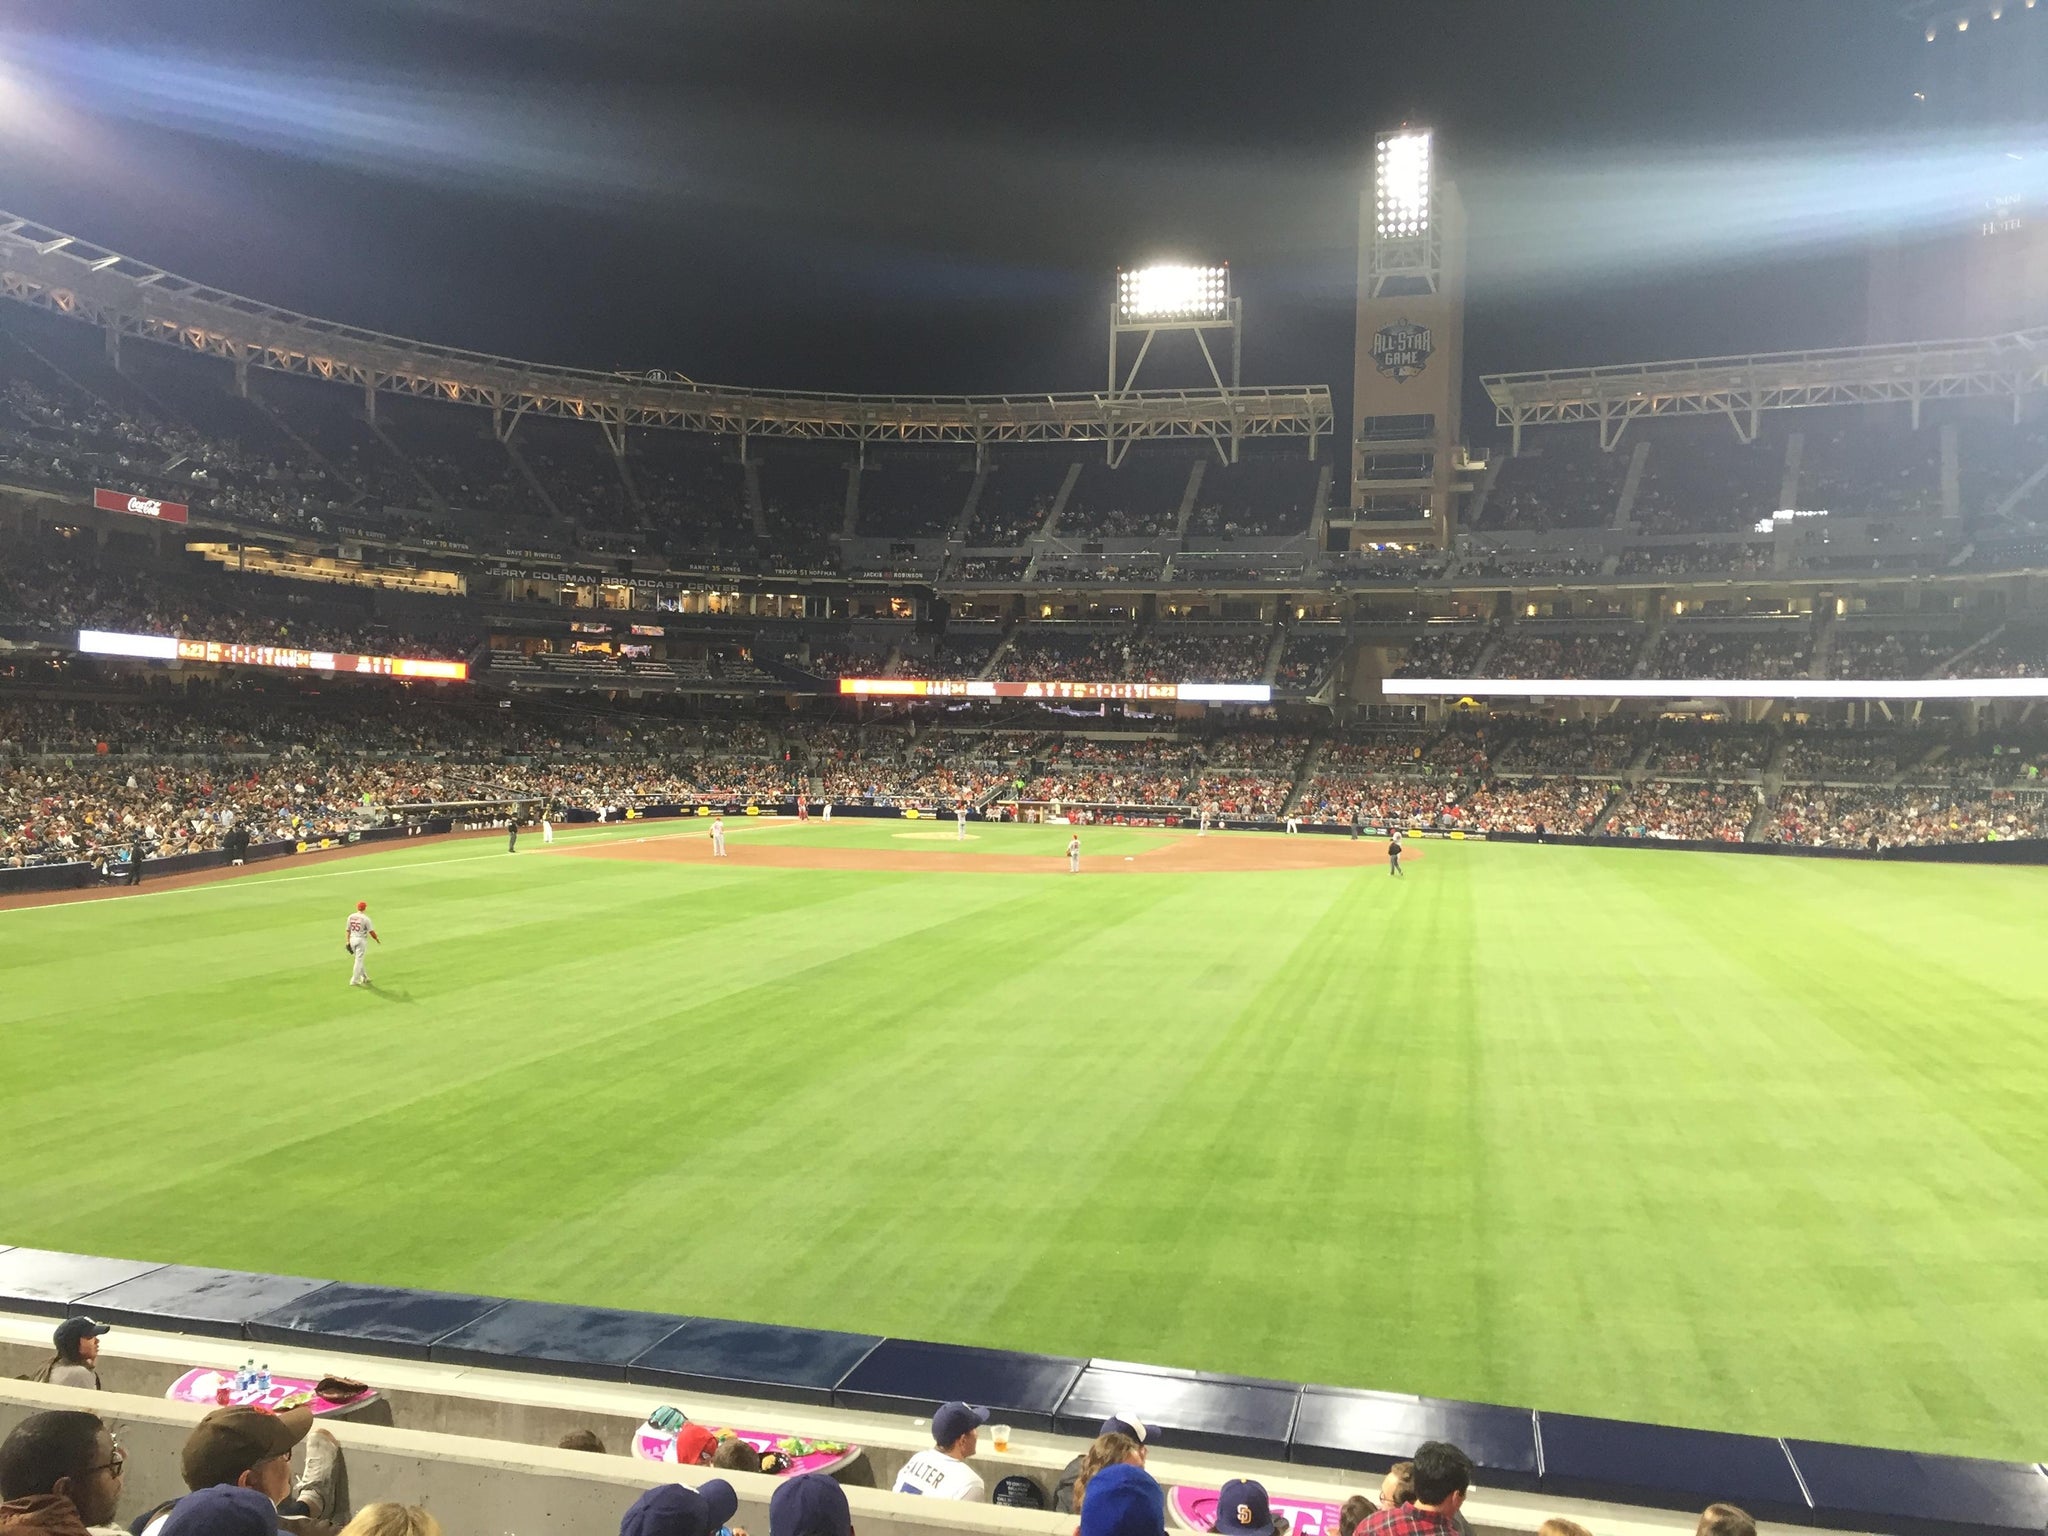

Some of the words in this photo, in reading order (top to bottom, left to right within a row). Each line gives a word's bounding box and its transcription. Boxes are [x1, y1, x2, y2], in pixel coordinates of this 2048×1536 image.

[1385, 351, 1418, 366] GAME
[485, 567, 527, 579] JERRY
[532, 571, 597, 584] COLEMAN
[601, 576, 683, 590] BROADCAST
[687, 581, 740, 593] CENTER
[350, 921, 361, 932] 55
